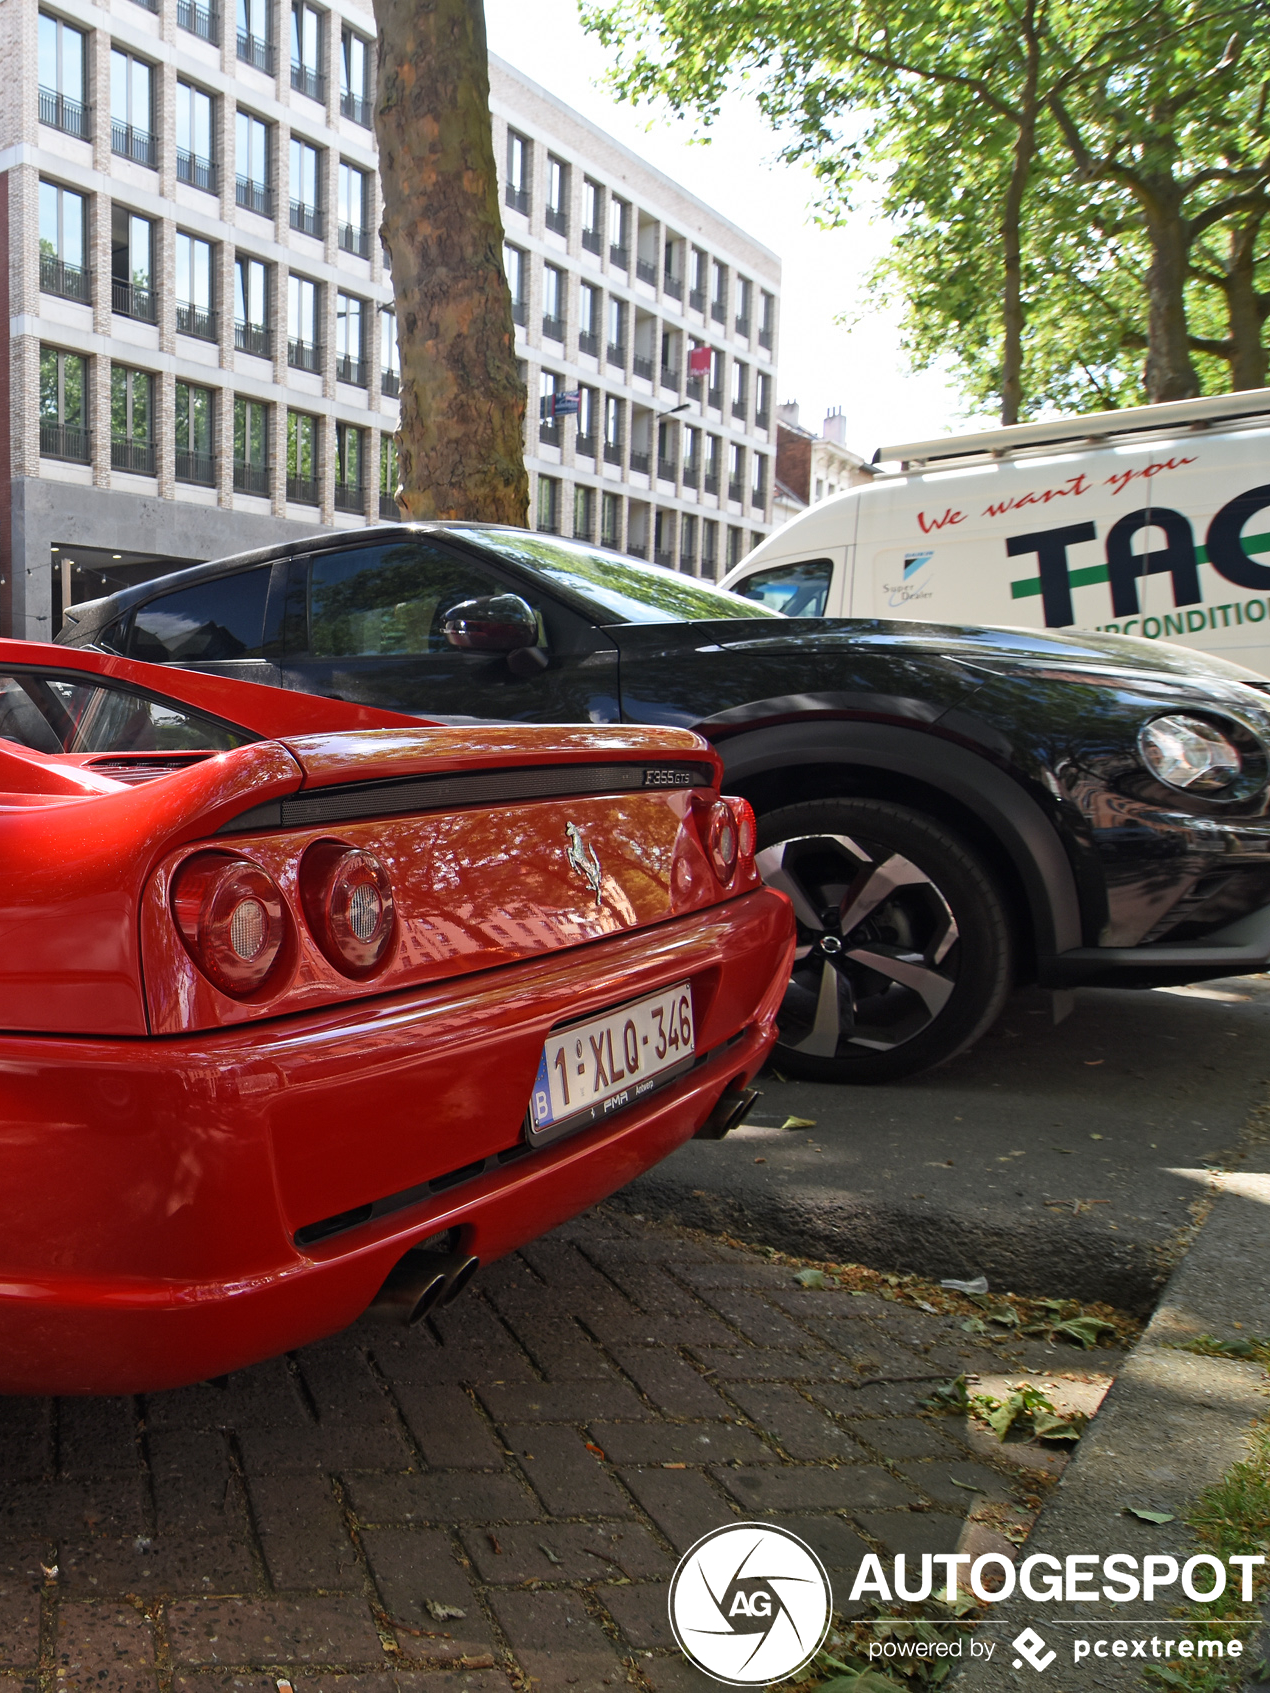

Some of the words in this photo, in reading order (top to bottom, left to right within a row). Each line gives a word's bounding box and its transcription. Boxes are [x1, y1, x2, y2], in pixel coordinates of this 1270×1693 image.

[917, 508, 968, 534] We
[981, 473, 1093, 517] want
[1102, 456, 1200, 496] you
[1083, 597, 1270, 640] CONDITIO
[535, 1090, 549, 1120] B
[635, 1080, 654, 1096] Antwerp
